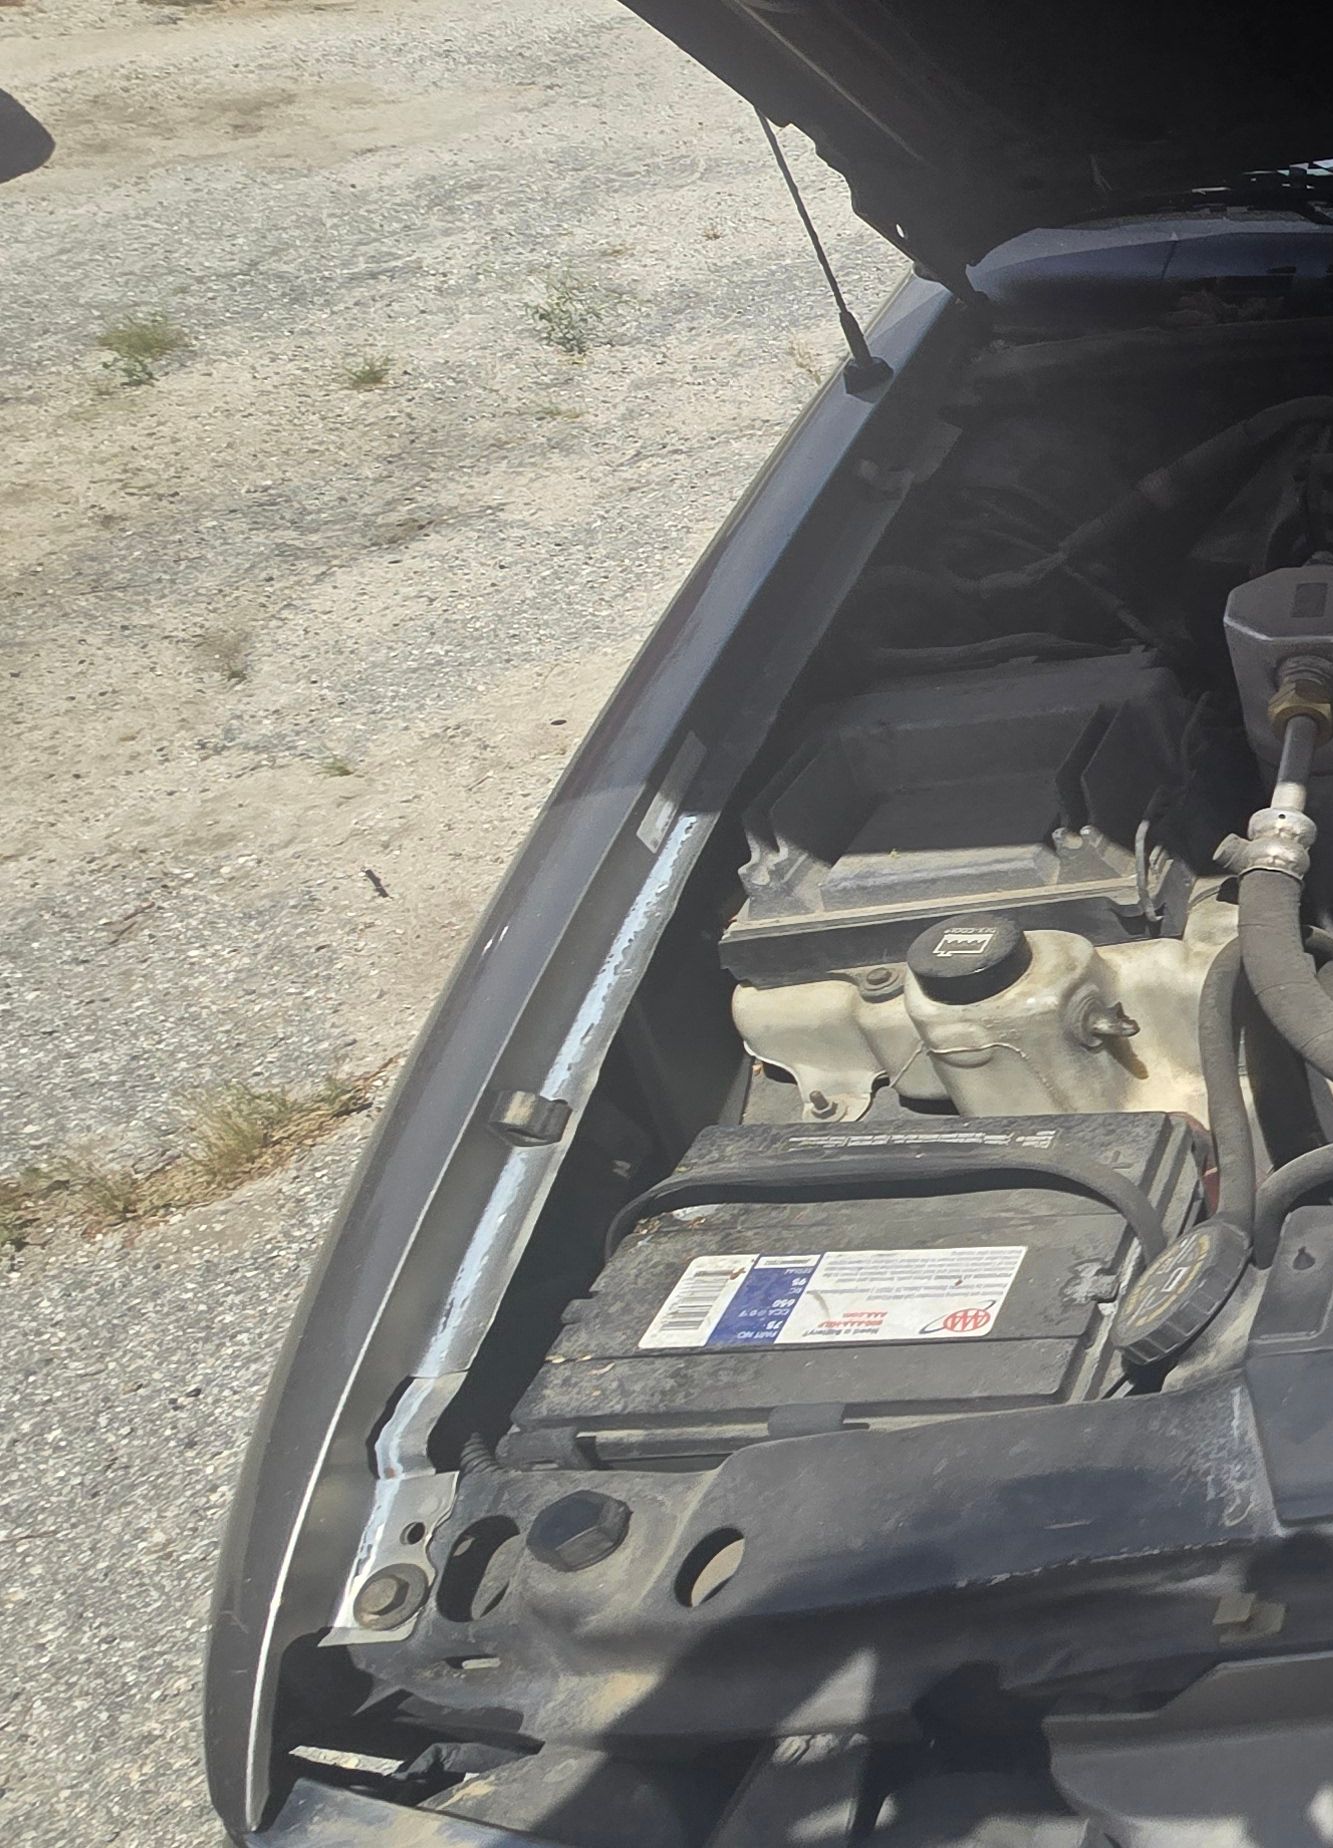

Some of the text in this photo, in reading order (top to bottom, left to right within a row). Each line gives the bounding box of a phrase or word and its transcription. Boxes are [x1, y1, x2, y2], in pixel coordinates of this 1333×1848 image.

[792, 1278, 807, 1286] 95
[772, 1298, 795, 1306] 650
[950, 1310, 986, 1328] AAA
[802, 1328, 841, 1337] Battery?
